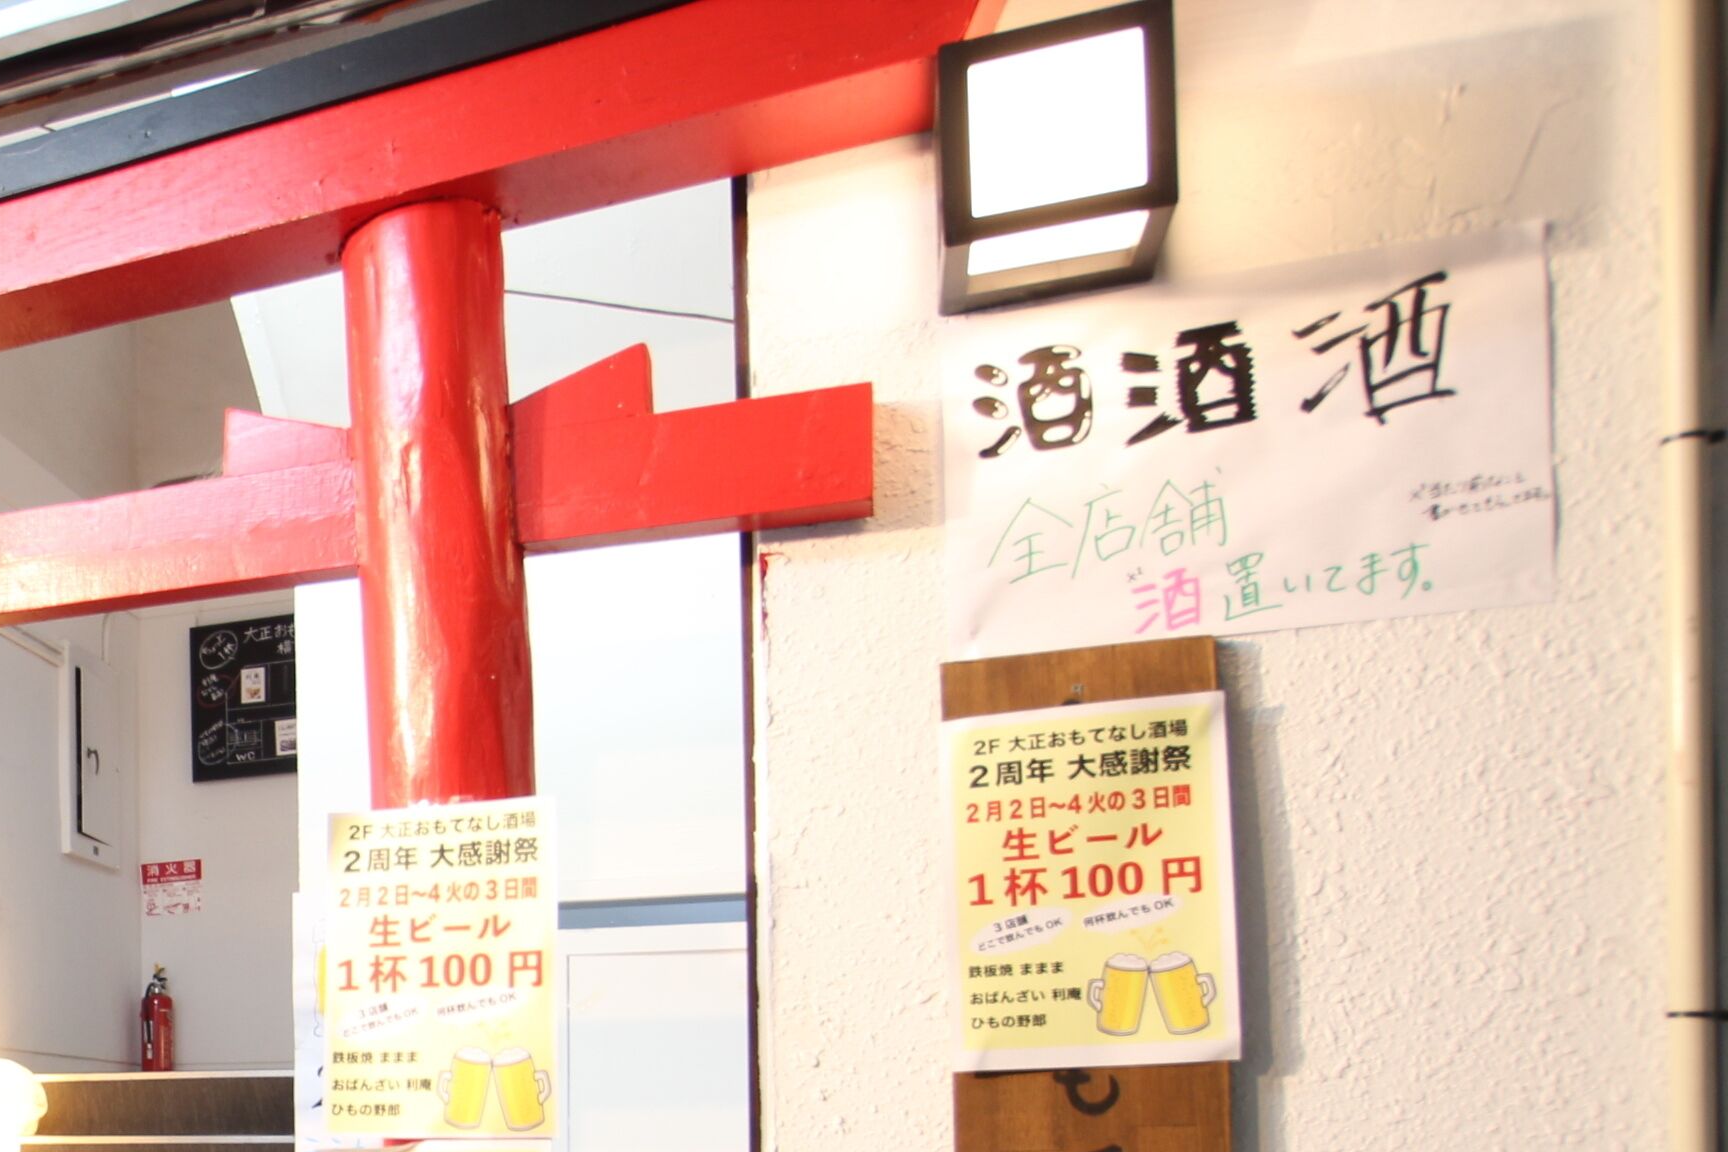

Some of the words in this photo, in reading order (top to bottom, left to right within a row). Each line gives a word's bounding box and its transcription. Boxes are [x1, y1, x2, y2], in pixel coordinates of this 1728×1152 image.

[986, 467, 1232, 586] 全店舗
[974, 740, 999, 755] 2F
[1008, 720, 1188, 752] 大正おもてなし酒場
[236, 752, 255, 761] WC
[968, 759, 1053, 788] 2周年
[1066, 744, 1192, 781] 大感謝祭
[349, 825, 371, 840] 2F
[379, 812, 535, 838] 大正おもてなし酒場
[343, 847, 418, 873] 2周年
[429, 836, 538, 869] 大感謝祭
[1002, 823, 1162, 862] 生ビール
[147, 860, 196, 876] 消火器
[370, 915, 511, 948] 生ビール
[969, 963, 1014, 978] 鉄板焼
[1021, 962, 1064, 977] ままま
[970, 988, 1045, 1005] おばんざい
[1052, 987, 1081, 1003] 利庵
[971, 1011, 1046, 1029] ひもの野郎
